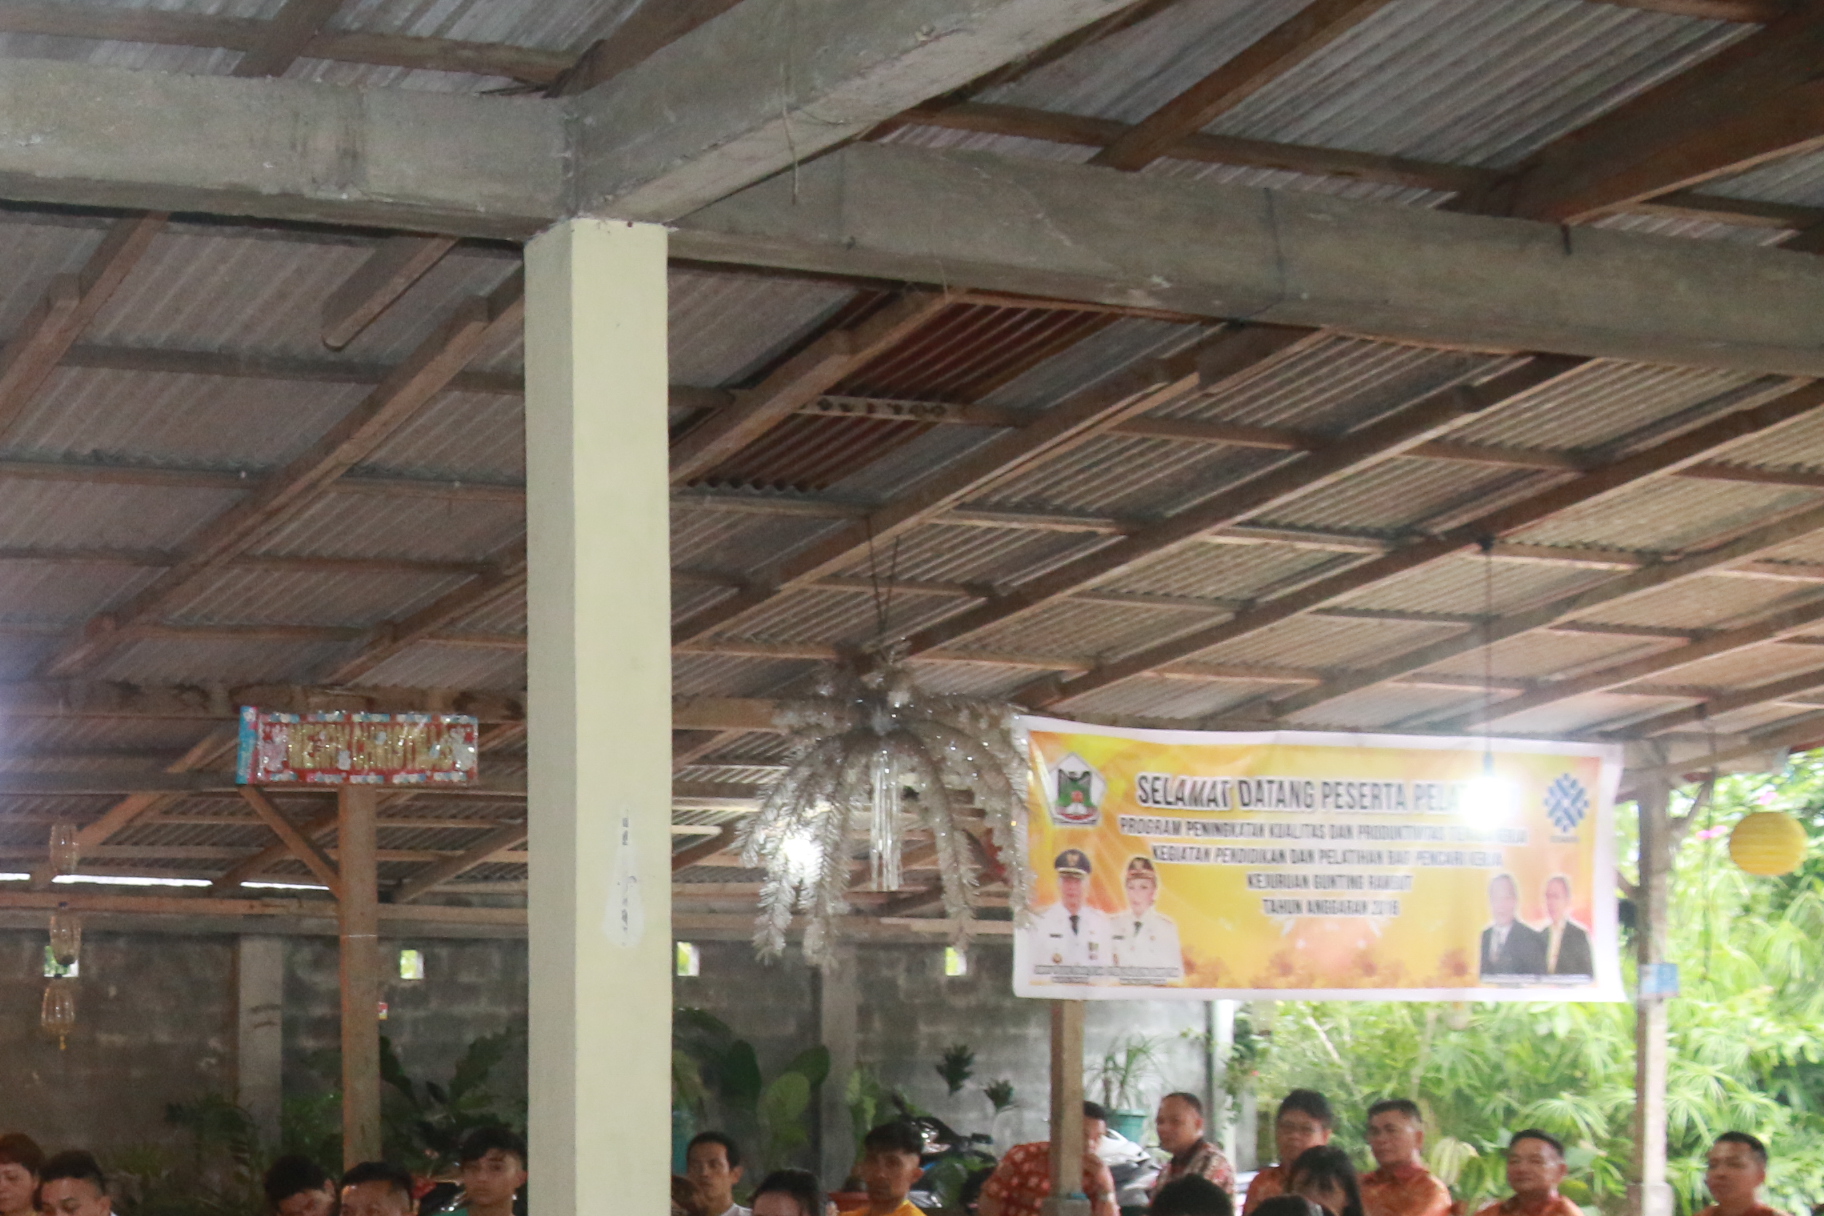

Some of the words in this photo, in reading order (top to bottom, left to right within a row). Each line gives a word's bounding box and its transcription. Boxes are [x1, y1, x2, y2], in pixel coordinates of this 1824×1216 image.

[1138, 775, 1230, 807] SELAMAT
[1238, 779, 1314, 809] DATANG
[1321, 781, 1407, 811] PESERTA
[1120, 816, 1182, 836] PROGRAM
[1330, 823, 1354, 840] DAN
[1152, 844, 1211, 862] KEGIATAN
[1215, 847, 1287, 864] PENDIDIKAN
[1289, 848, 1315, 864] DAN
[1318, 849, 1383, 865] PELATIHAN
[1247, 873, 1309, 890] KEJURUAN
[1314, 874, 1363, 890] GUNTING
[1262, 899, 1303, 915] TAHUN
[1306, 899, 1368, 916] ANGGARAN
